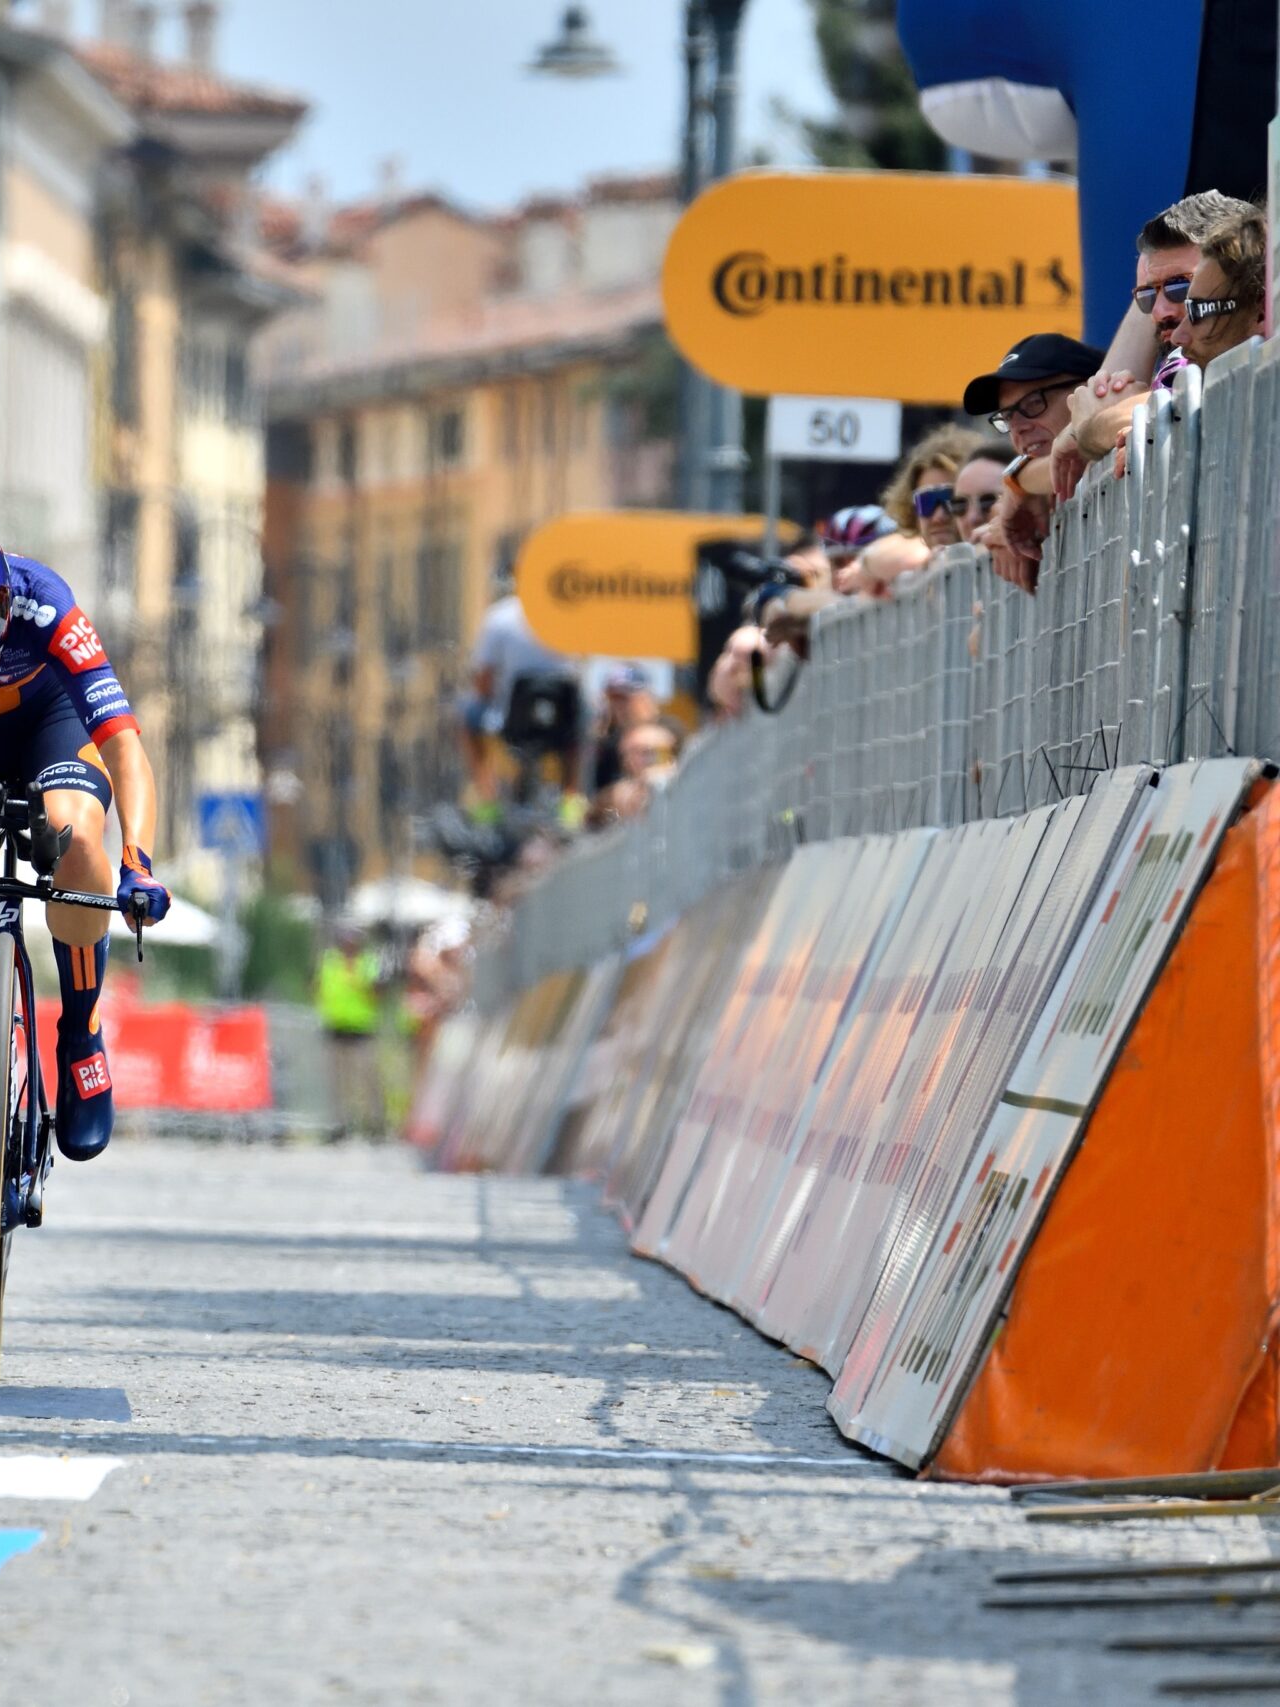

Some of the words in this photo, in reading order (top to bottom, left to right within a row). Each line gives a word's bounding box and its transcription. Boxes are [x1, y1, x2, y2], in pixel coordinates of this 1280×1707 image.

[712, 250, 1026, 318] Continental
[808, 411, 860, 446] 50
[51, 891, 120, 908] LAPIERRE
[78, 1060, 103, 1080] PIC
